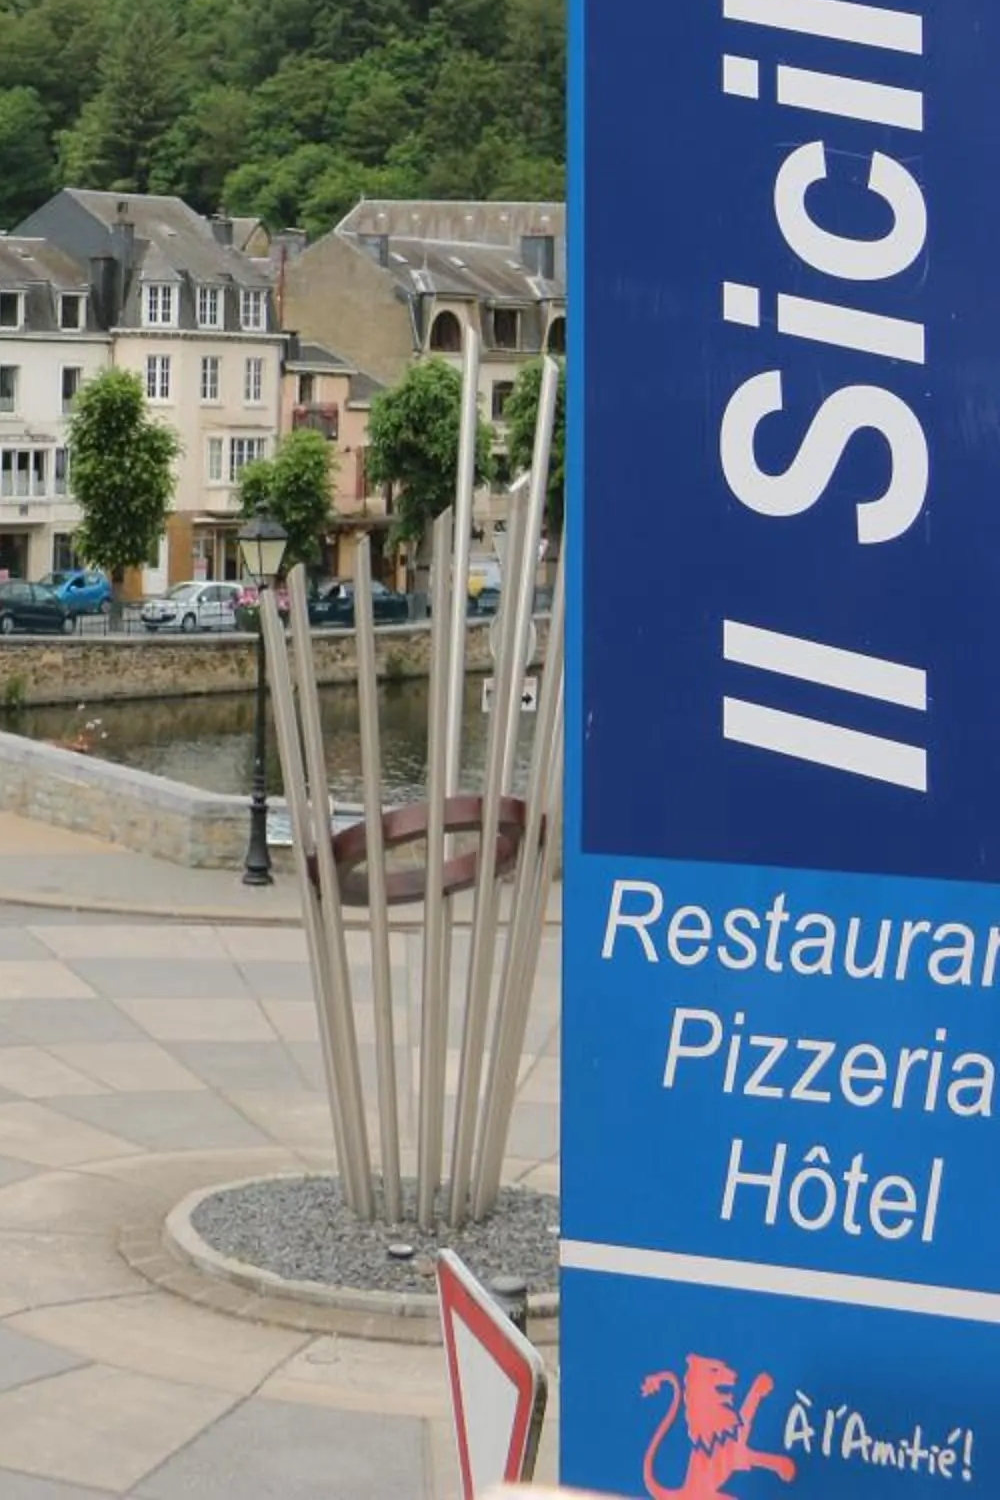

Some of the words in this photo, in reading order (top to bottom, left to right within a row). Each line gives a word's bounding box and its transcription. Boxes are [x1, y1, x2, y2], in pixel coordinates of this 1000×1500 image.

[722, 618, 928, 793] Il
[662, 1007, 996, 1118] Pizzeria
[720, 1139, 944, 1243] Hôtel
[784, 1389, 815, 1453] À
